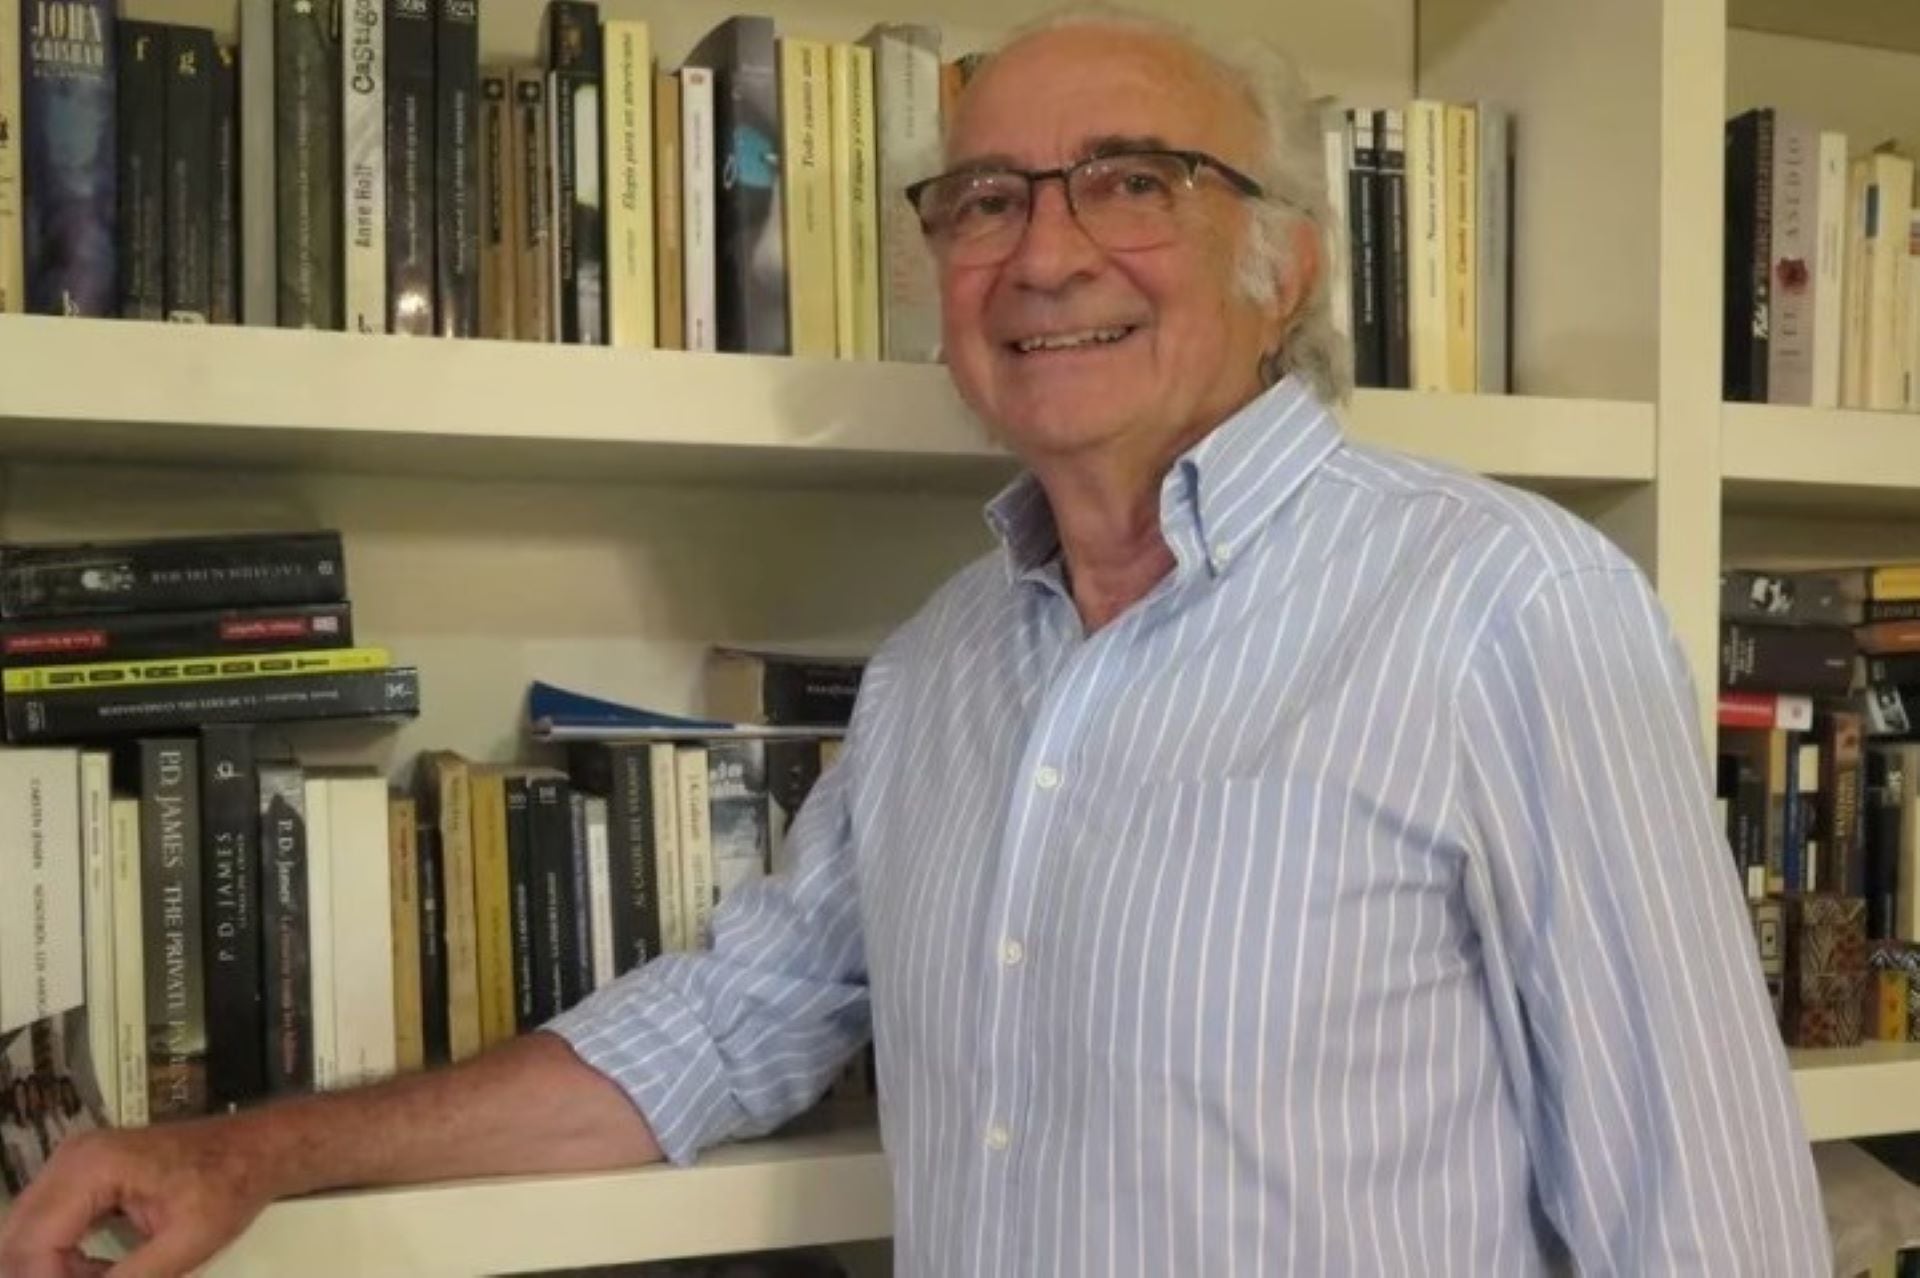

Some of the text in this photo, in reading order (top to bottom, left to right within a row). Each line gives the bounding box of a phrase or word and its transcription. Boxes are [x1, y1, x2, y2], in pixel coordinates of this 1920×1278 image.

[31, 1, 101, 42] JOHN
[355, 164, 373, 248] Anne Holt
[156, 796, 184, 868] JAMES
[215, 832, 234, 907] JAMES
[164, 884, 184, 929] THE
[166, 932, 187, 1012] PRIVATE
